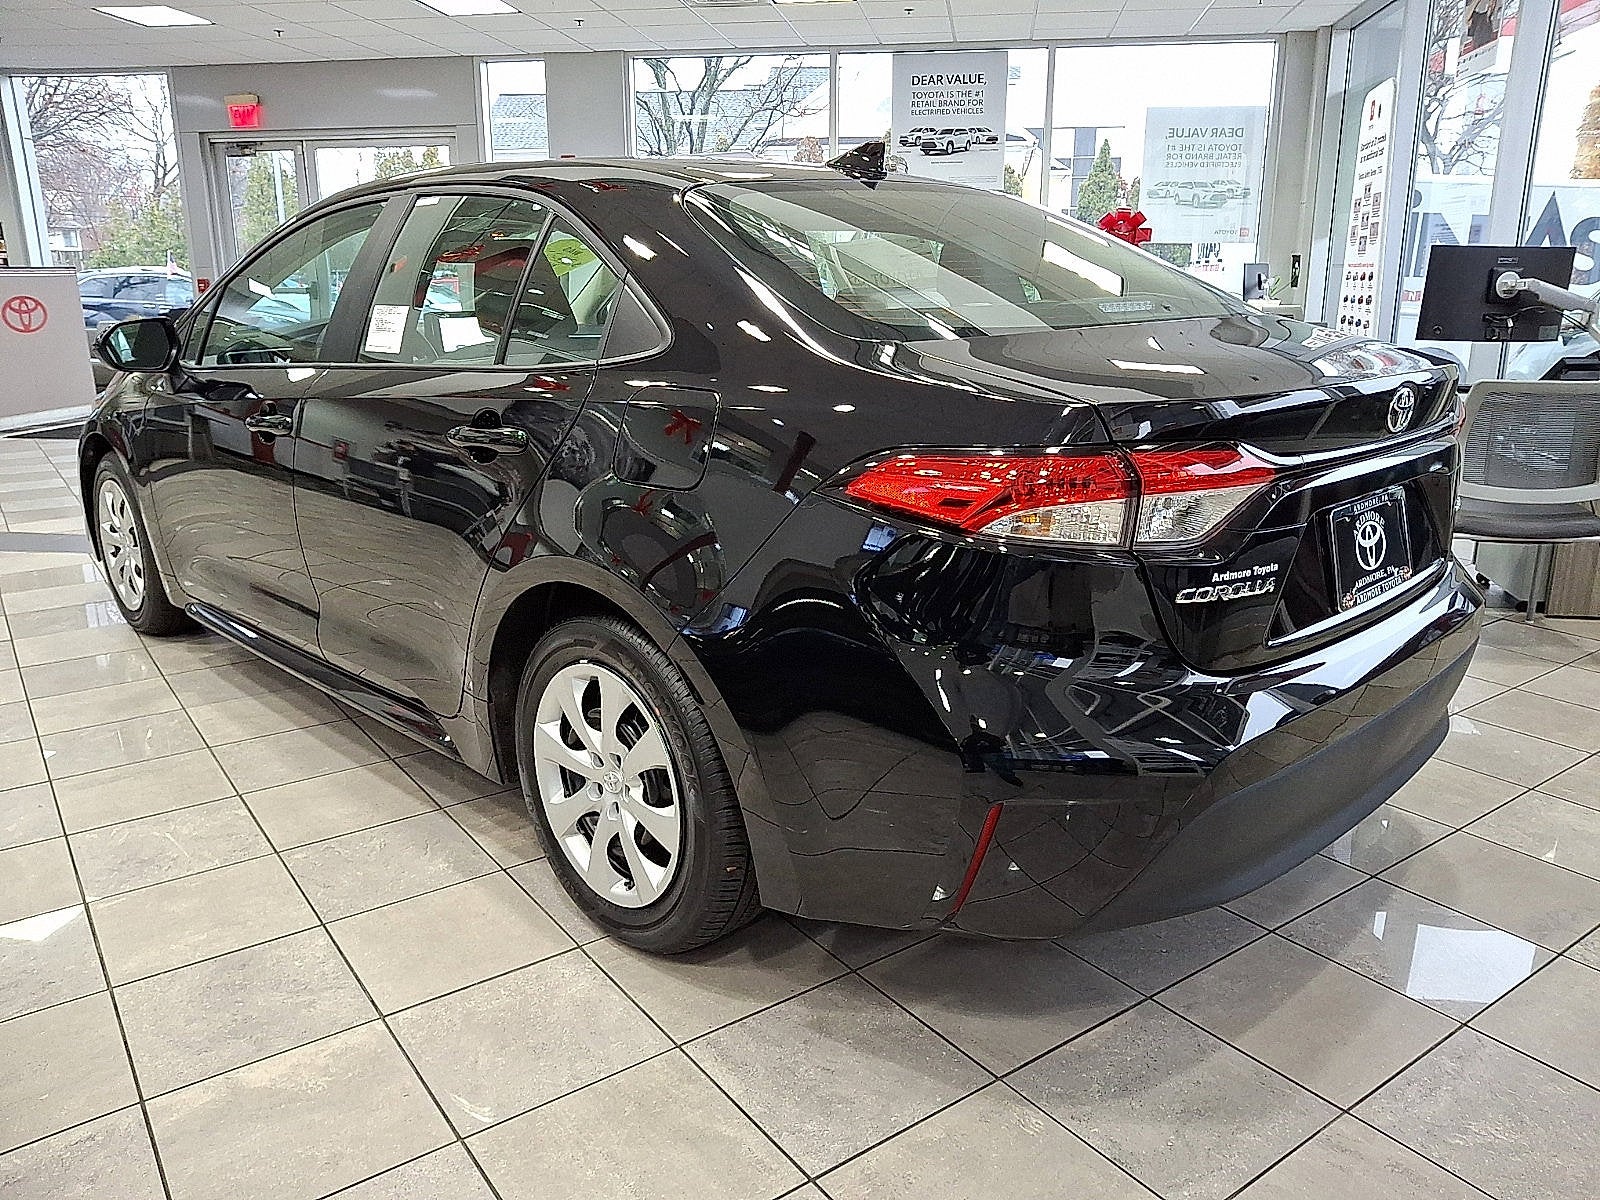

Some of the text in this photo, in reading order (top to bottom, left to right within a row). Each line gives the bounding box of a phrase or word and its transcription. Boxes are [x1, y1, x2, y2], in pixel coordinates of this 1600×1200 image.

[911, 74, 987, 86] DEAR VALUE,
[912, 91, 945, 99] TOYOTA
[956, 90, 972, 98] THE
[974, 90, 985, 98] #1
[911, 99, 984, 108] RETAIL BRAND FOR
[911, 108, 951, 116] ELECTRIFIED
[1212, 563, 1279, 583] Ardmore Toyota
[1175, 577, 1276, 603] COROLLA
